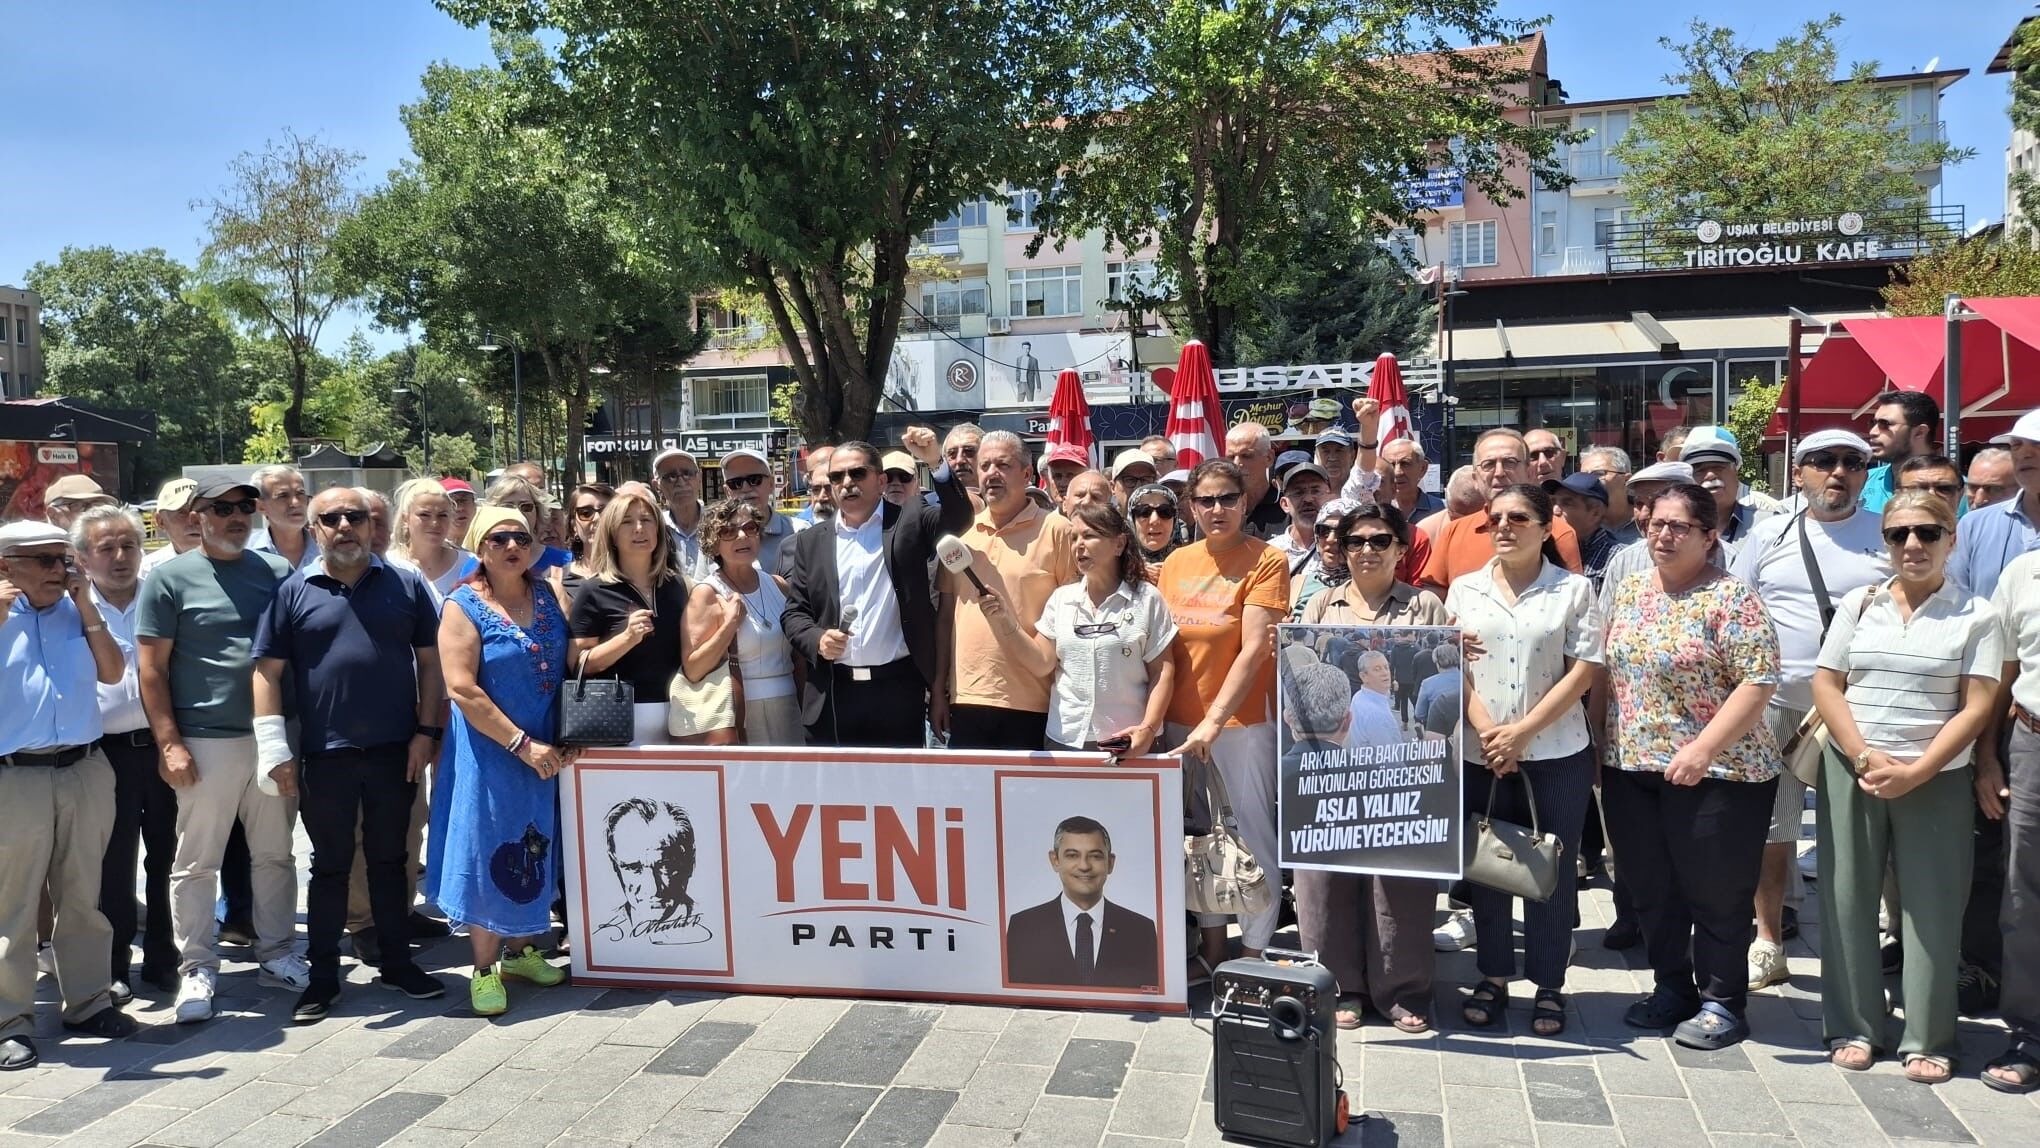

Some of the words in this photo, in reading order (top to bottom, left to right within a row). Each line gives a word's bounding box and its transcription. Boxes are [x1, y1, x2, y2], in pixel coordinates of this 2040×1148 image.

[1726, 223, 1759, 237] UŞAK
[1762, 217, 1833, 234] BELEDİYESİ
[1683, 242, 1801, 267] TİRİTOĞLU
[1817, 241, 1880, 260] KAFE
[685, 437, 709, 451] AS
[1300, 749, 1347, 771] ARKANA
[1350, 746, 1373, 766] HER
[1376, 738, 1446, 763] BAKTIĞINDA
[1298, 772, 1367, 795] MİLYONLARI
[1369, 761, 1445, 789] GÖRECEKSİN.
[1315, 797, 1358, 823] ASLA
[1362, 791, 1421, 819] YALNIZ
[1290, 814, 1449, 854] YÜRÜMEYECEKSİN!
